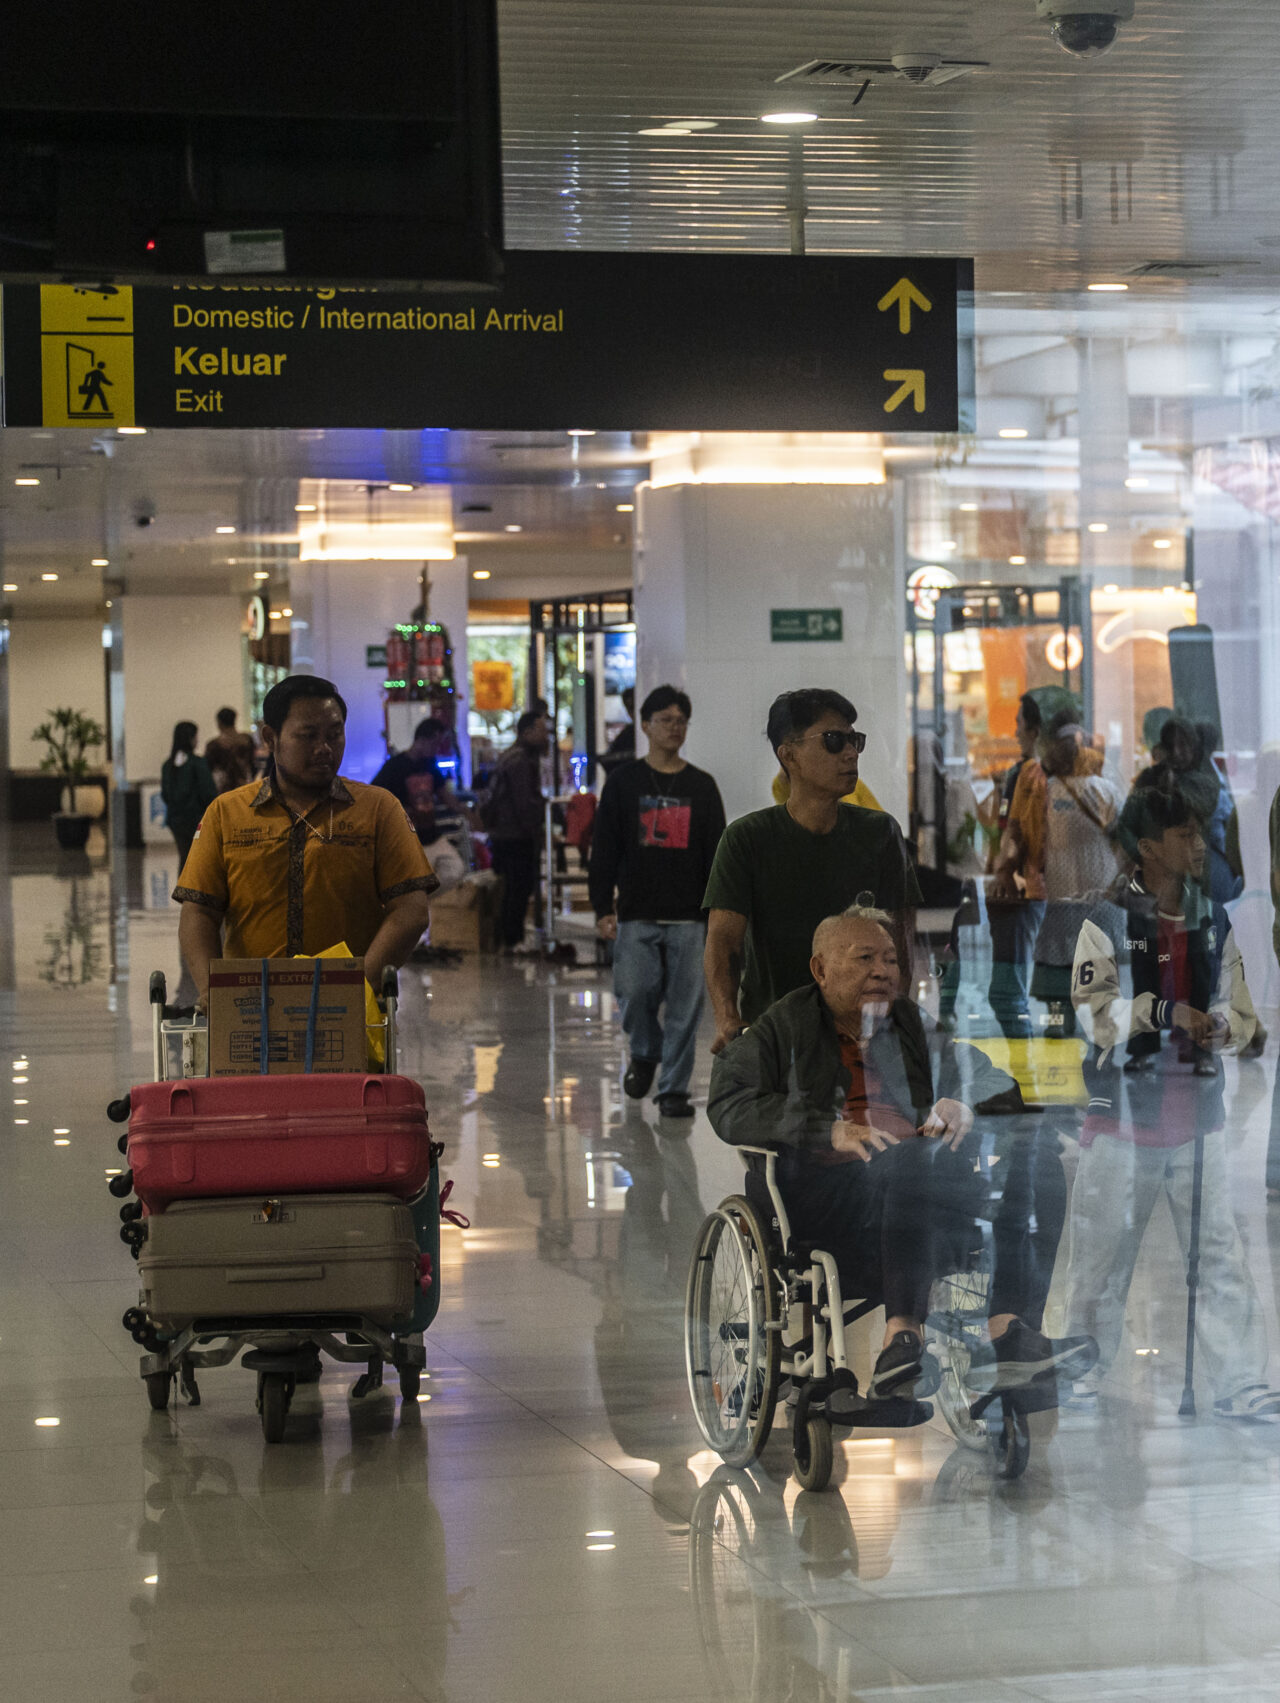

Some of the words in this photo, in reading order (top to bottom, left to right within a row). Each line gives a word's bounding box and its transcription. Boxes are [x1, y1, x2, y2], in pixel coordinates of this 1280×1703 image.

[173, 304, 294, 329] Domestic
[301, 305, 311, 329] /
[320, 306, 475, 331] International
[484, 308, 563, 332] Arrival
[174, 347, 287, 376] Keluar
[175, 389, 223, 413] Exit
[239, 975, 261, 985] BEL
